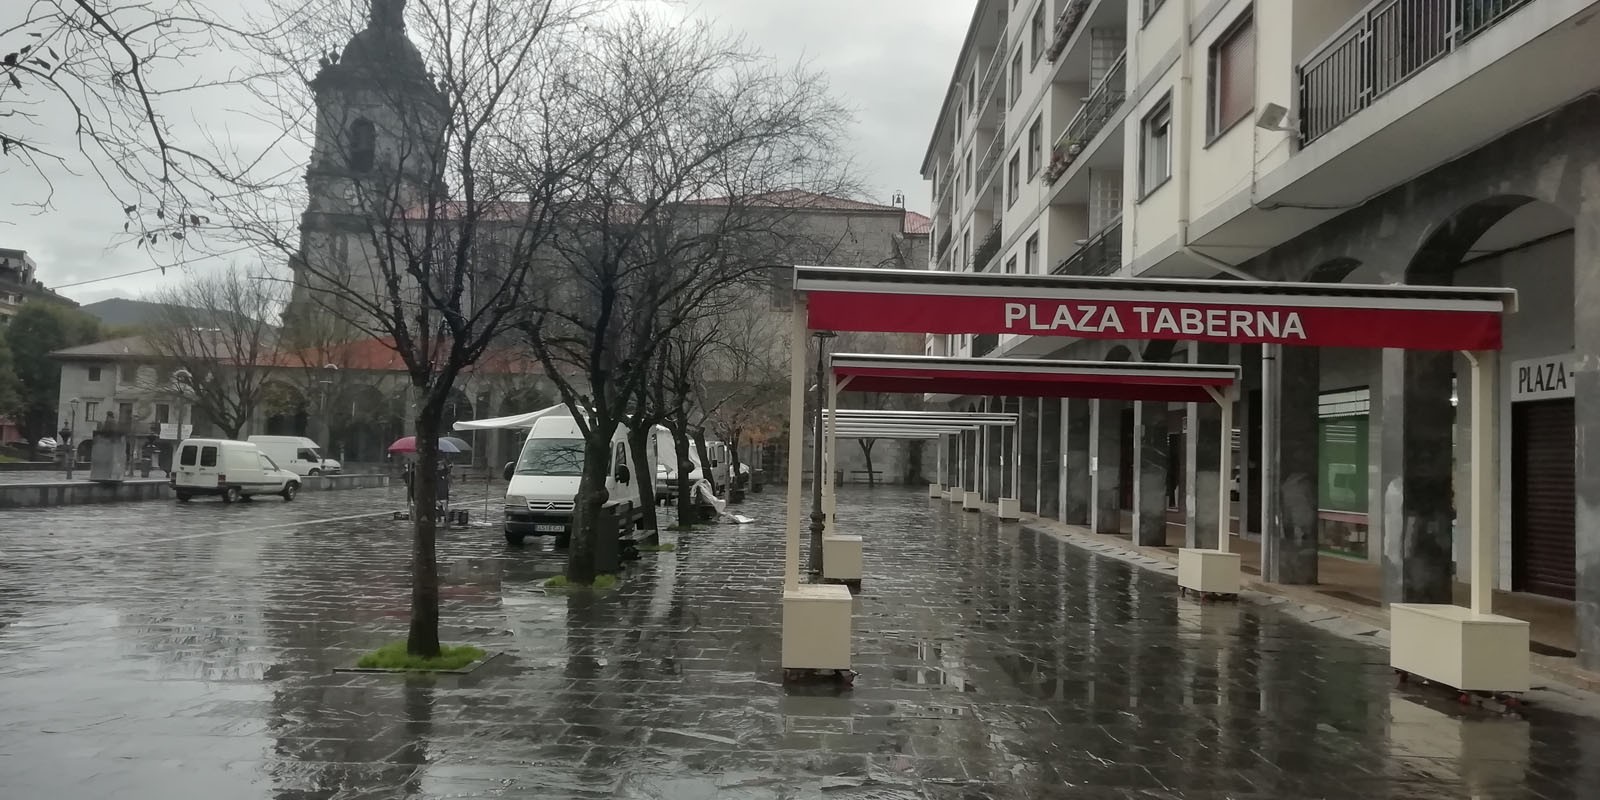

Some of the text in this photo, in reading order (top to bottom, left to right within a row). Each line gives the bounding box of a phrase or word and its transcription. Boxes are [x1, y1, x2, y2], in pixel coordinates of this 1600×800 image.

[1004, 303, 1307, 339] PLAZA TABERNA
[1519, 361, 1567, 393] PLAZA
